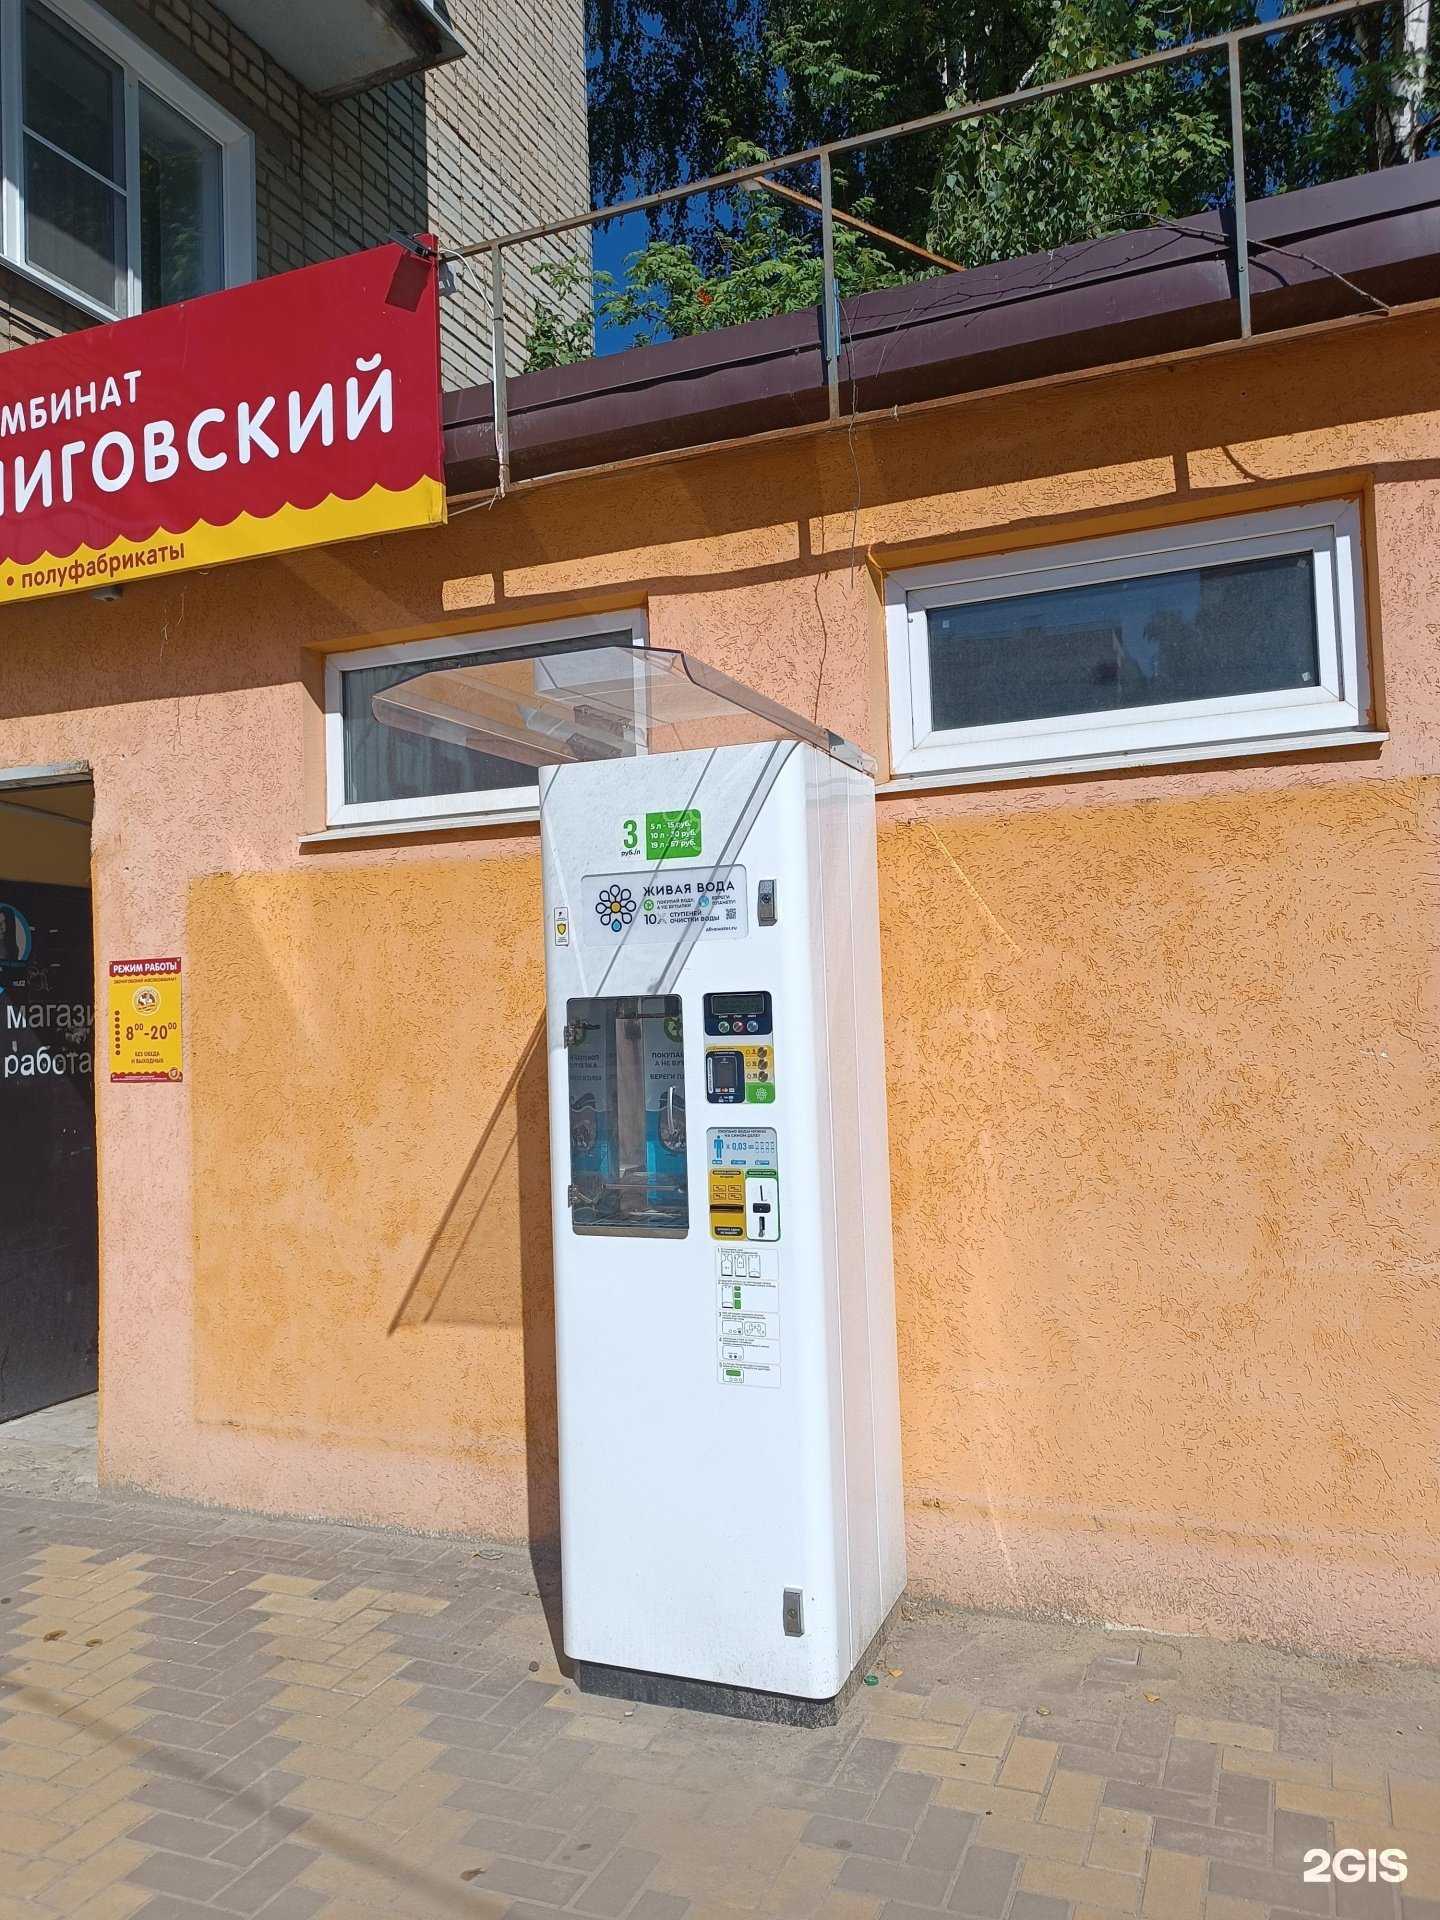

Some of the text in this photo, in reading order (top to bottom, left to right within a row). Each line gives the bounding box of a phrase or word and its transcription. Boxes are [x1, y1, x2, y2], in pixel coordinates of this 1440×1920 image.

[0, 370, 142, 438] МБИНАТ
[0, 353, 393, 517] ИГОВСКИЙ
[21, 542, 186, 589] полуфабрикаты
[623, 820, 638, 849] 3
[651, 841, 659, 849] 19
[642, 880, 735, 897] ЖИВАЯ ВОДА
[643, 913, 657, 925] 10
[669, 916, 699, 924] ОЧИСТКИ
[113, 961, 177, 974] РЕЖИМ РАБОТЫ
